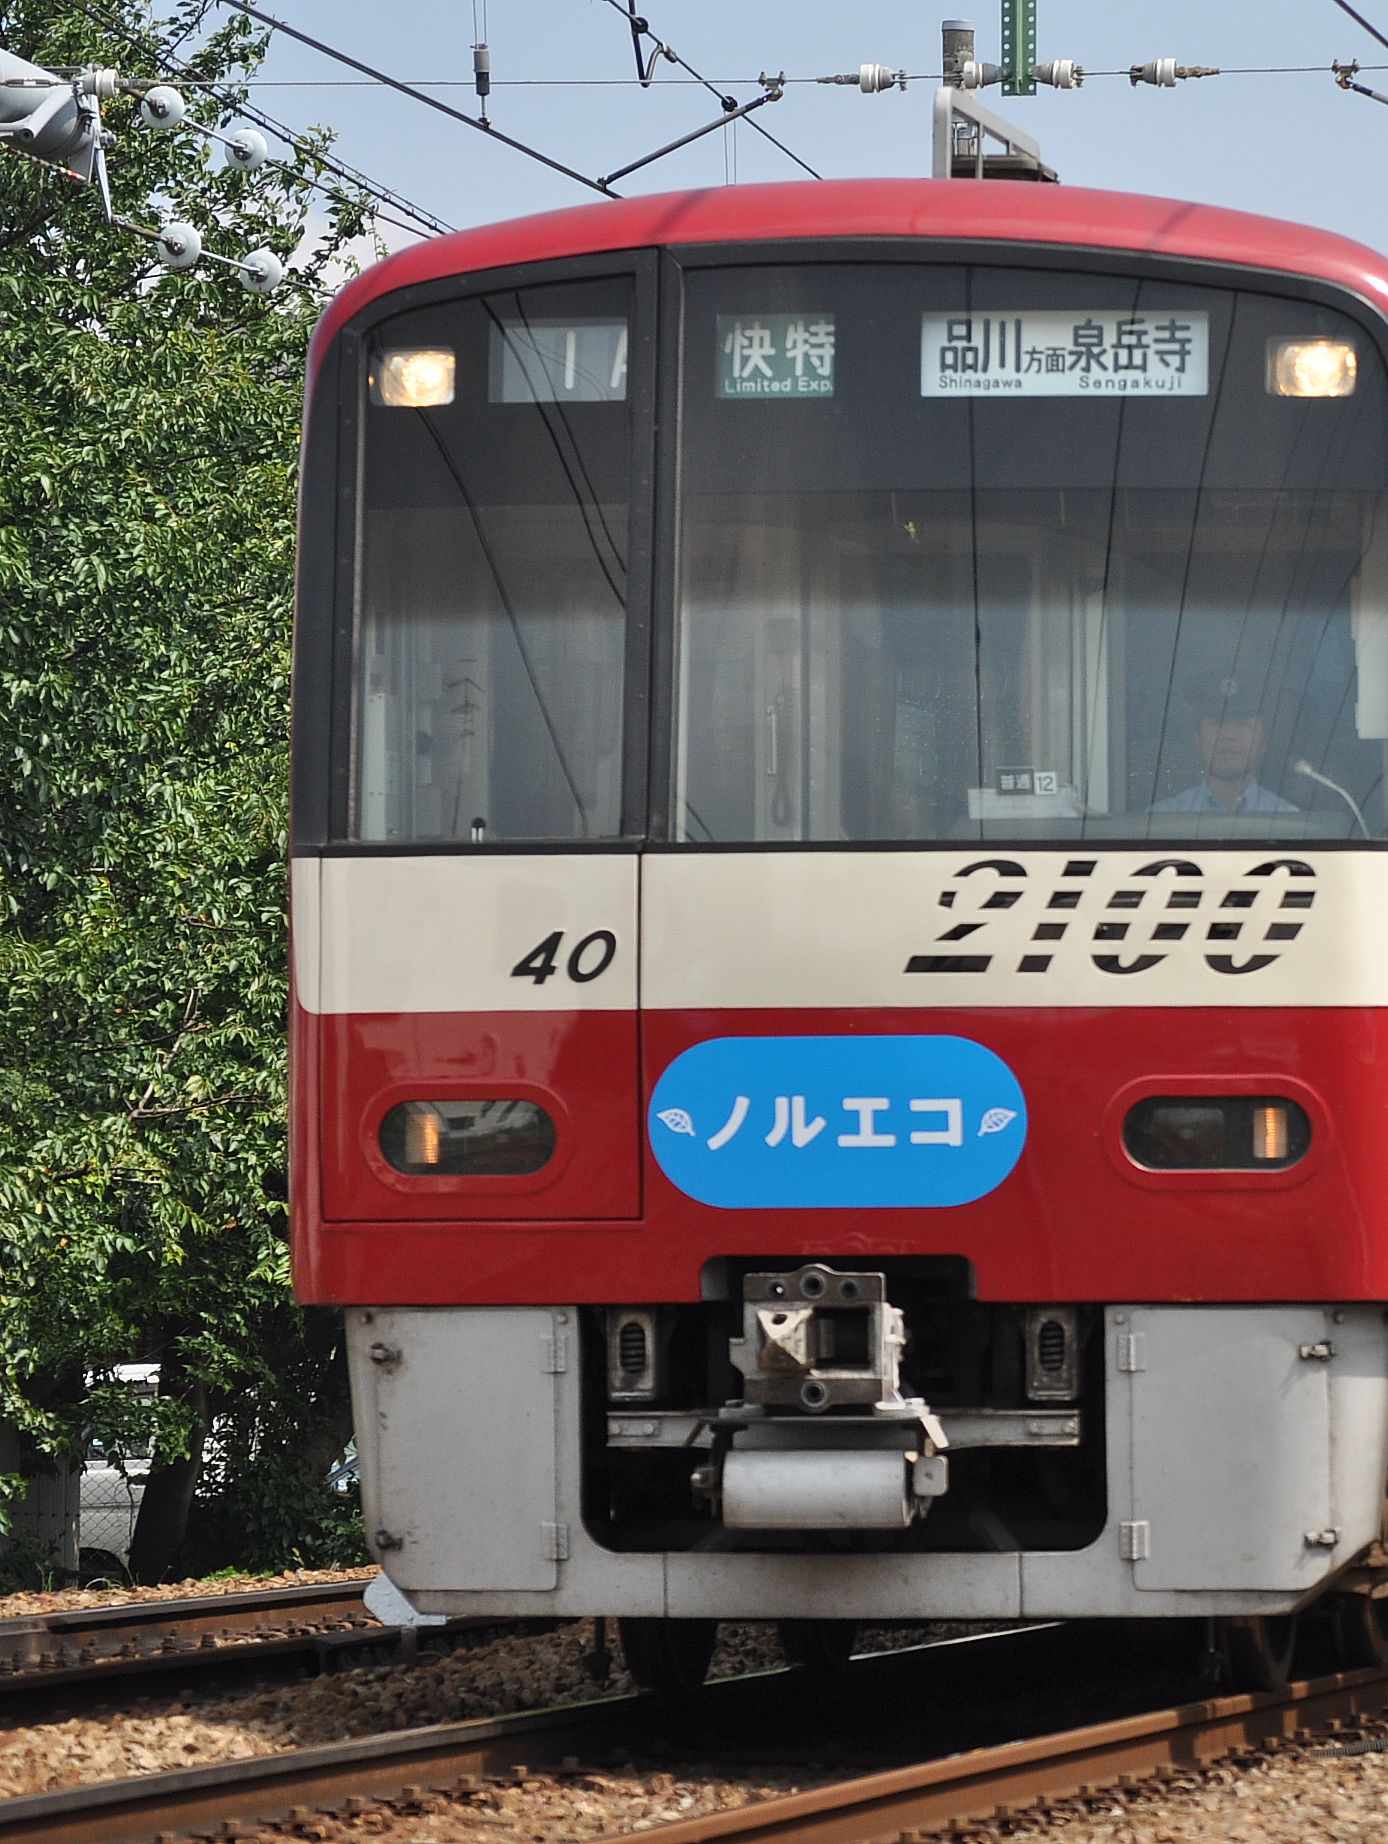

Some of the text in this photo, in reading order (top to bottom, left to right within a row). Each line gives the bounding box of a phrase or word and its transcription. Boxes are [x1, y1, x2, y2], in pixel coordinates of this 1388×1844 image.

[725, 320, 835, 378] 快特
[725, 377, 793, 393] Limited
[938, 375, 1023, 391] Shinagawa
[1078, 376, 1182, 392] Sengakuji
[1037, 775, 1055, 792] 12
[903, 858, 1317, 975] 2100
[511, 930, 617, 985] 40
[706, 1095, 964, 1150] ノルエコ
